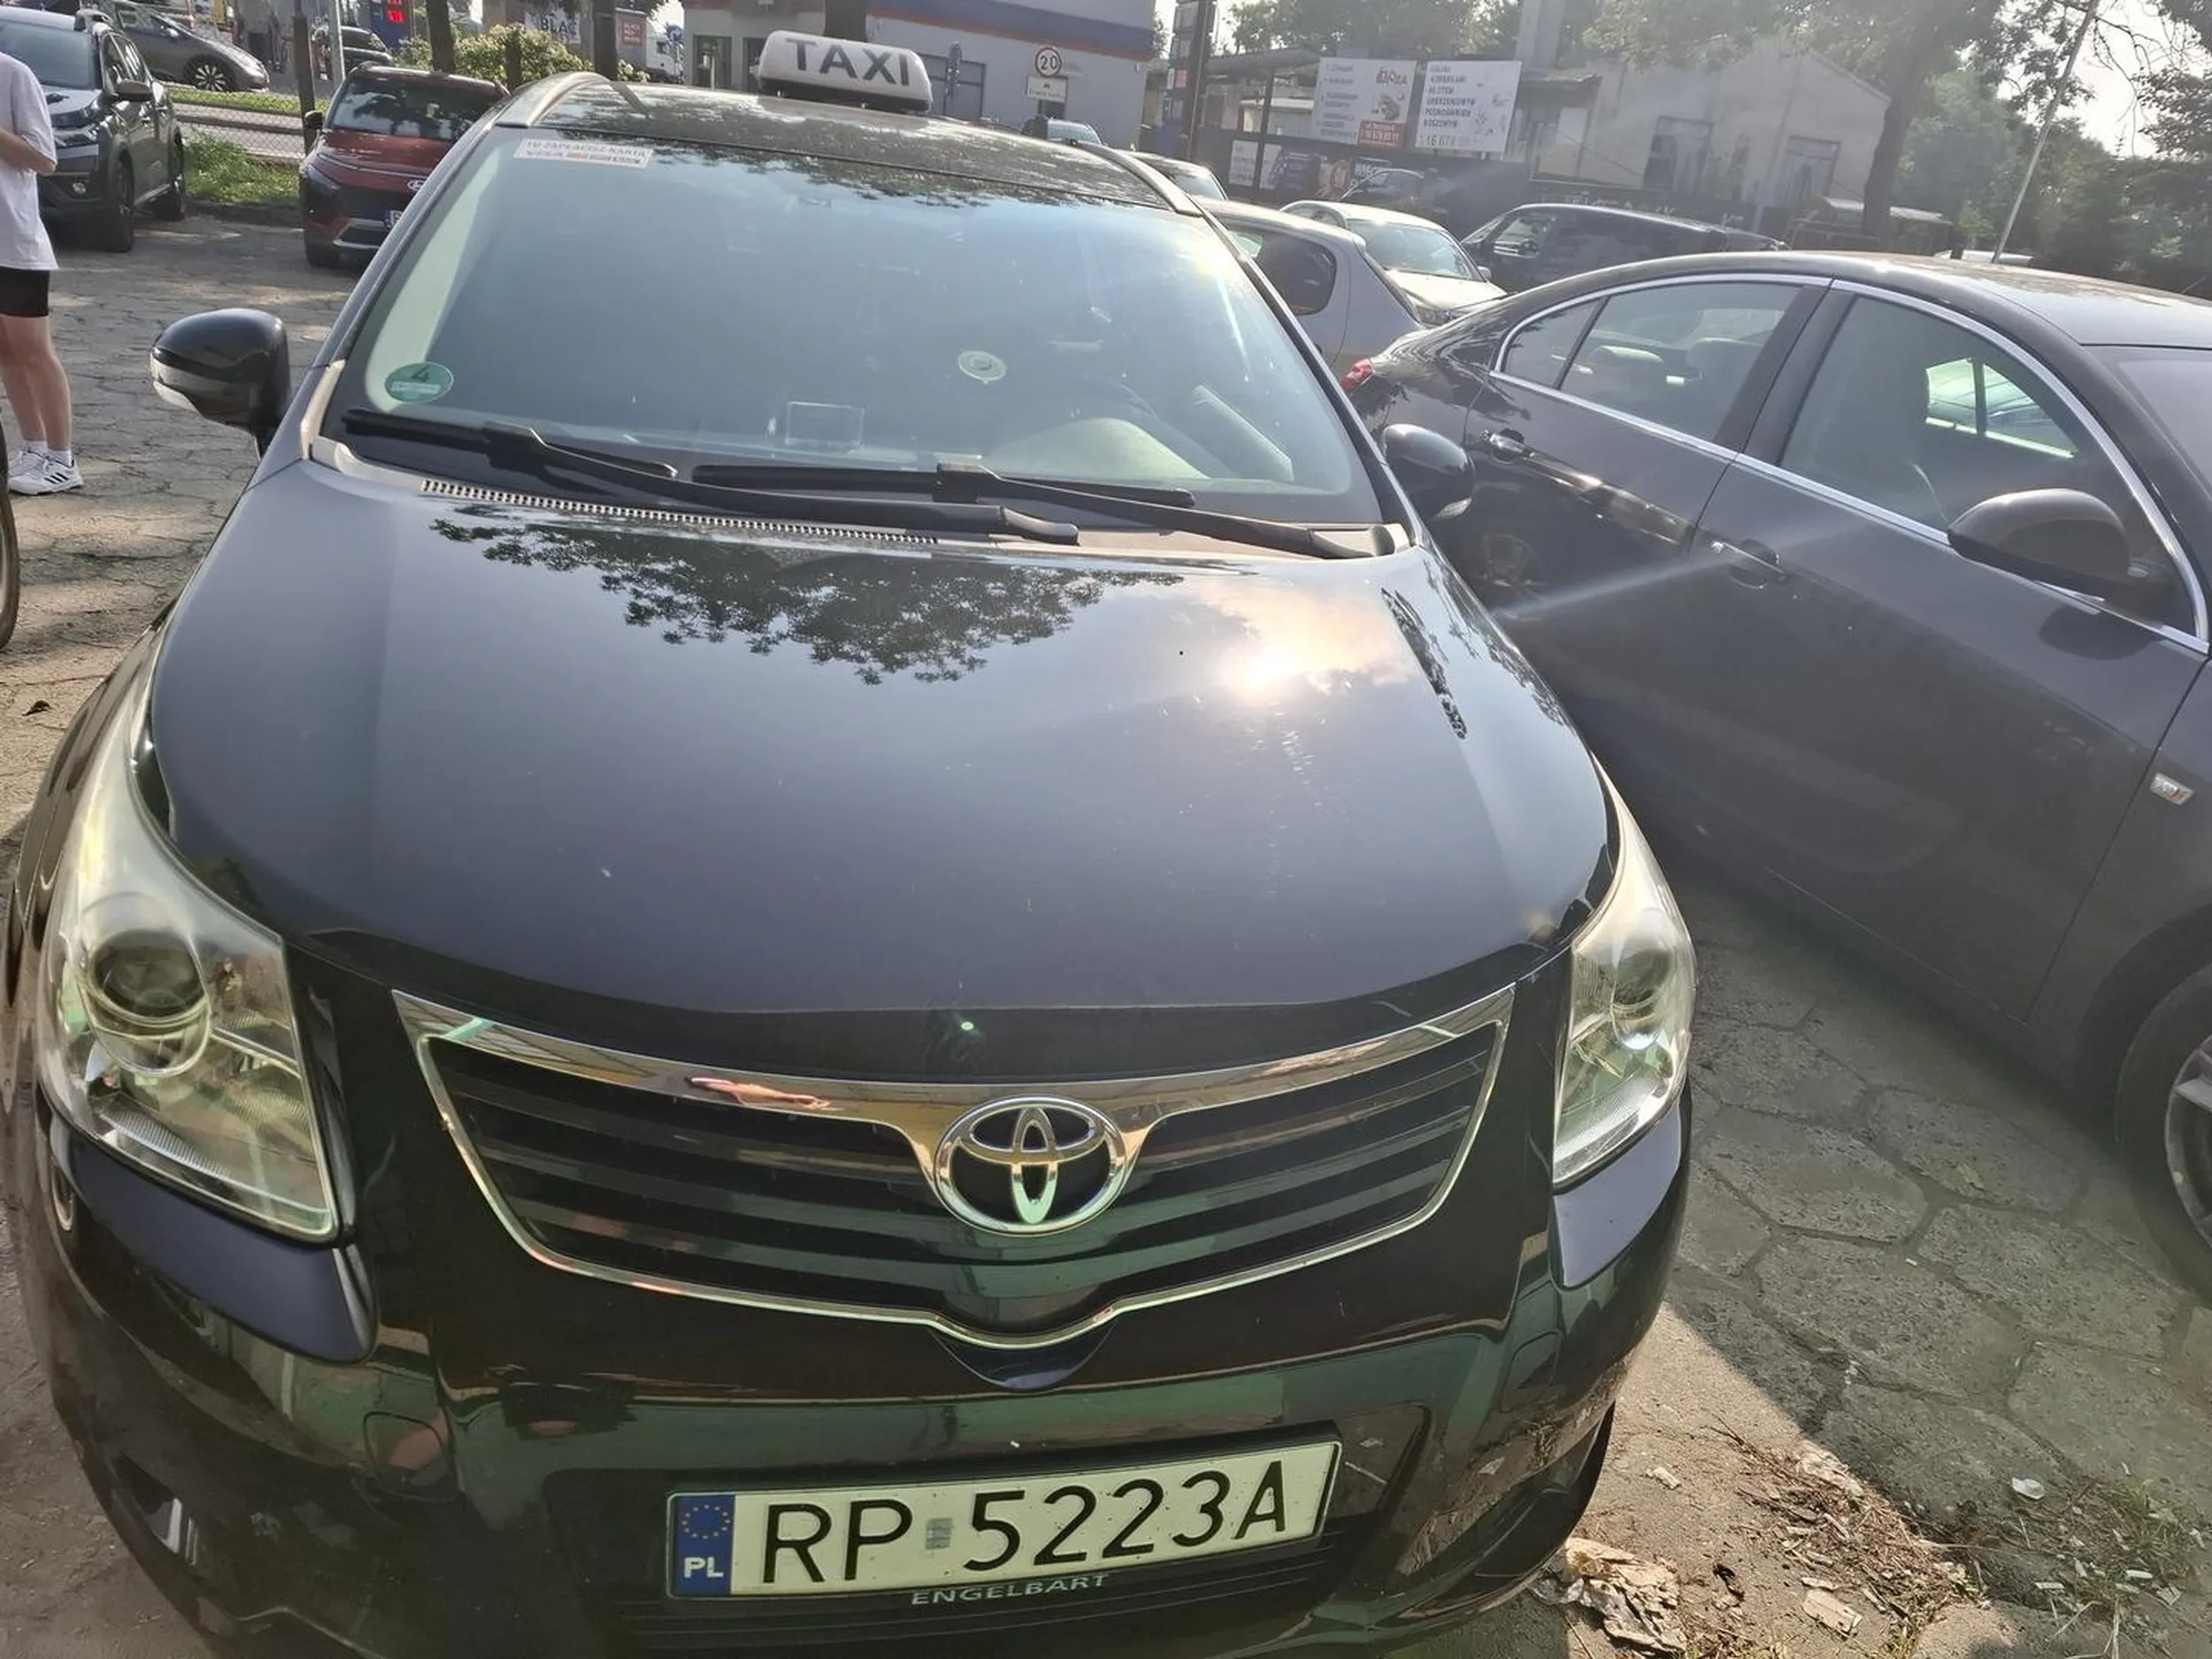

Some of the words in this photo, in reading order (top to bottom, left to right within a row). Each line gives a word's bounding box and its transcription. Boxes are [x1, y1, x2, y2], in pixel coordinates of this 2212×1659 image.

[786, 38, 910, 87] TAXI
[1040, 54, 1059, 71] 20
[762, 1498, 913, 1584] RP
[963, 1460, 1286, 1571] 5223A
[683, 1556, 725, 1578] PL
[911, 1573, 1110, 1606] ENGELBART
